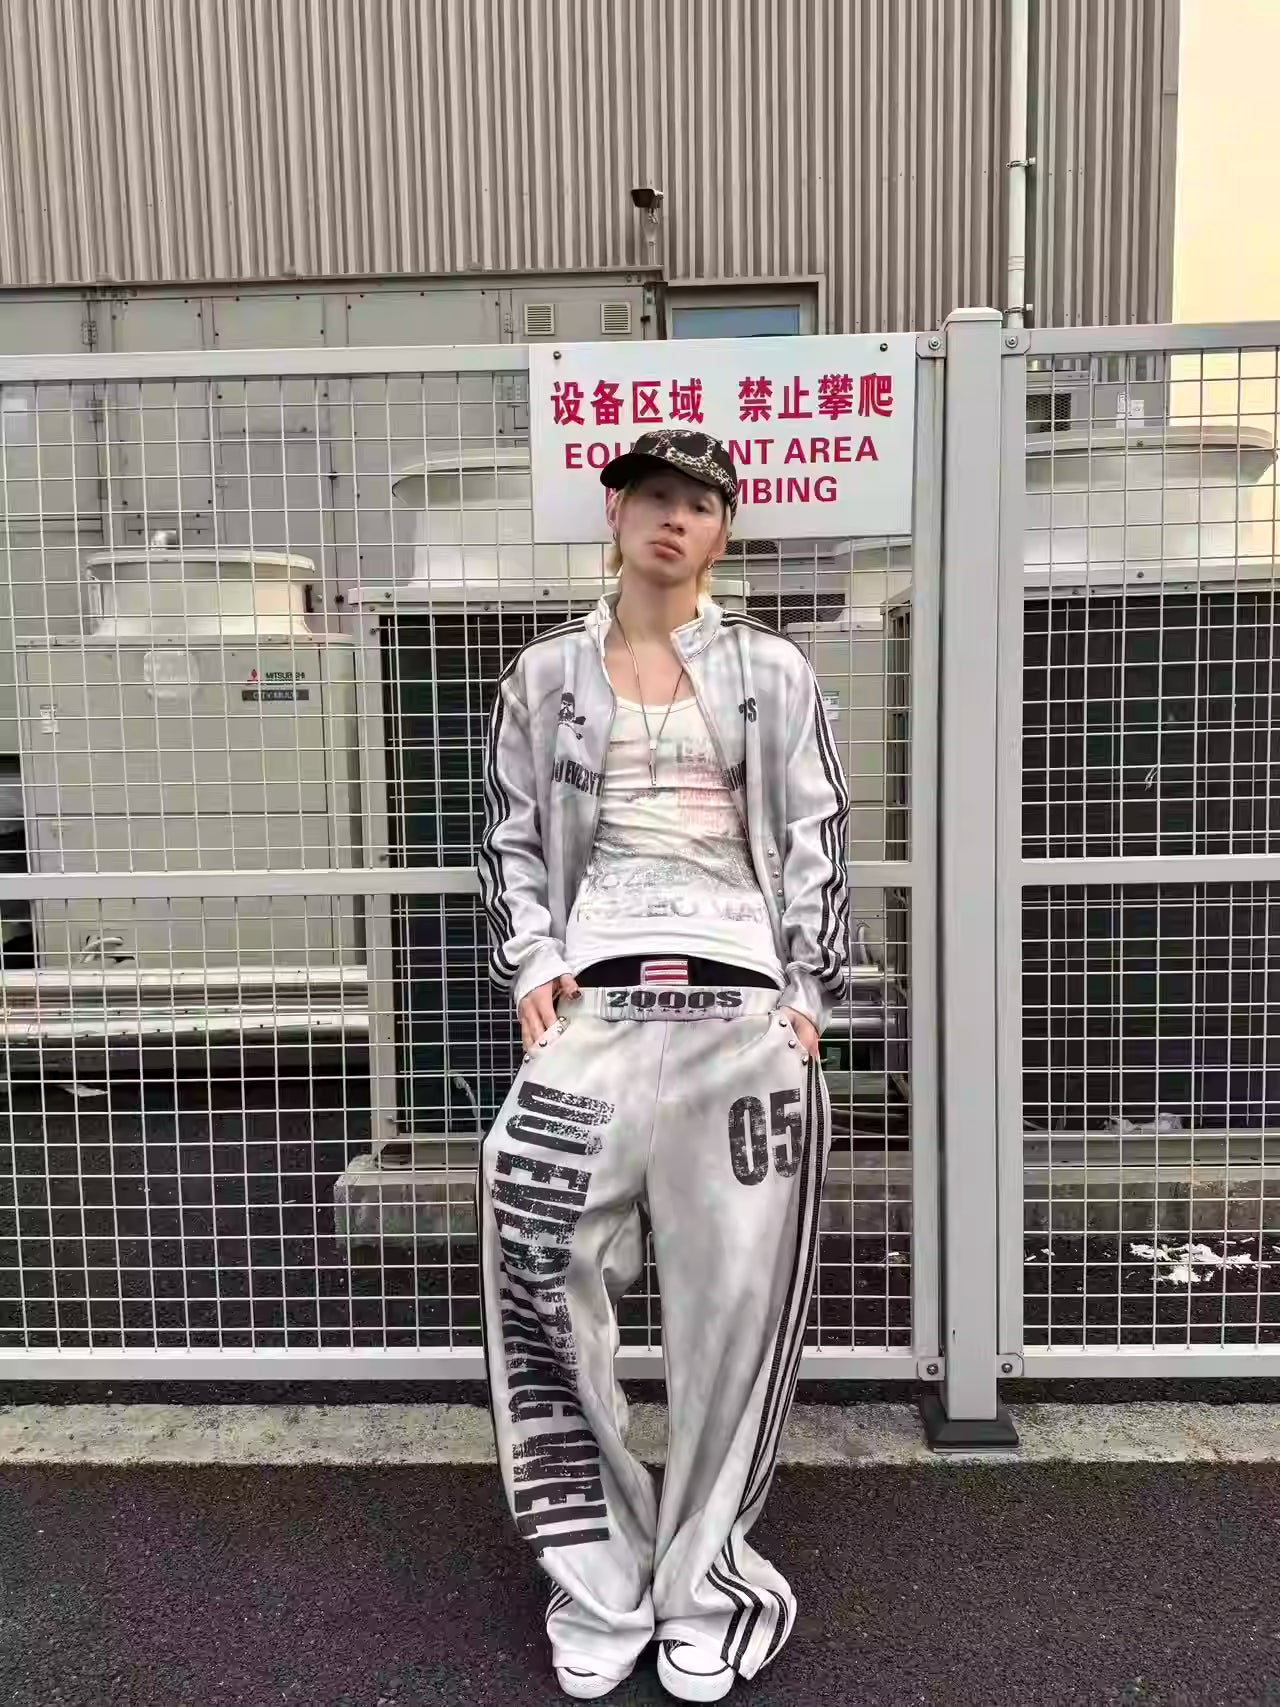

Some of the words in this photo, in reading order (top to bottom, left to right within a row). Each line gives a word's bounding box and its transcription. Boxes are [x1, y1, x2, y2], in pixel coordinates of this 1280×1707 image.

[550, 377, 704, 426] 设备区域
[738, 372, 894, 423] 禁止攀爬
[784, 436, 879, 464] AREA
[607, 990, 743, 1009] 2000S
